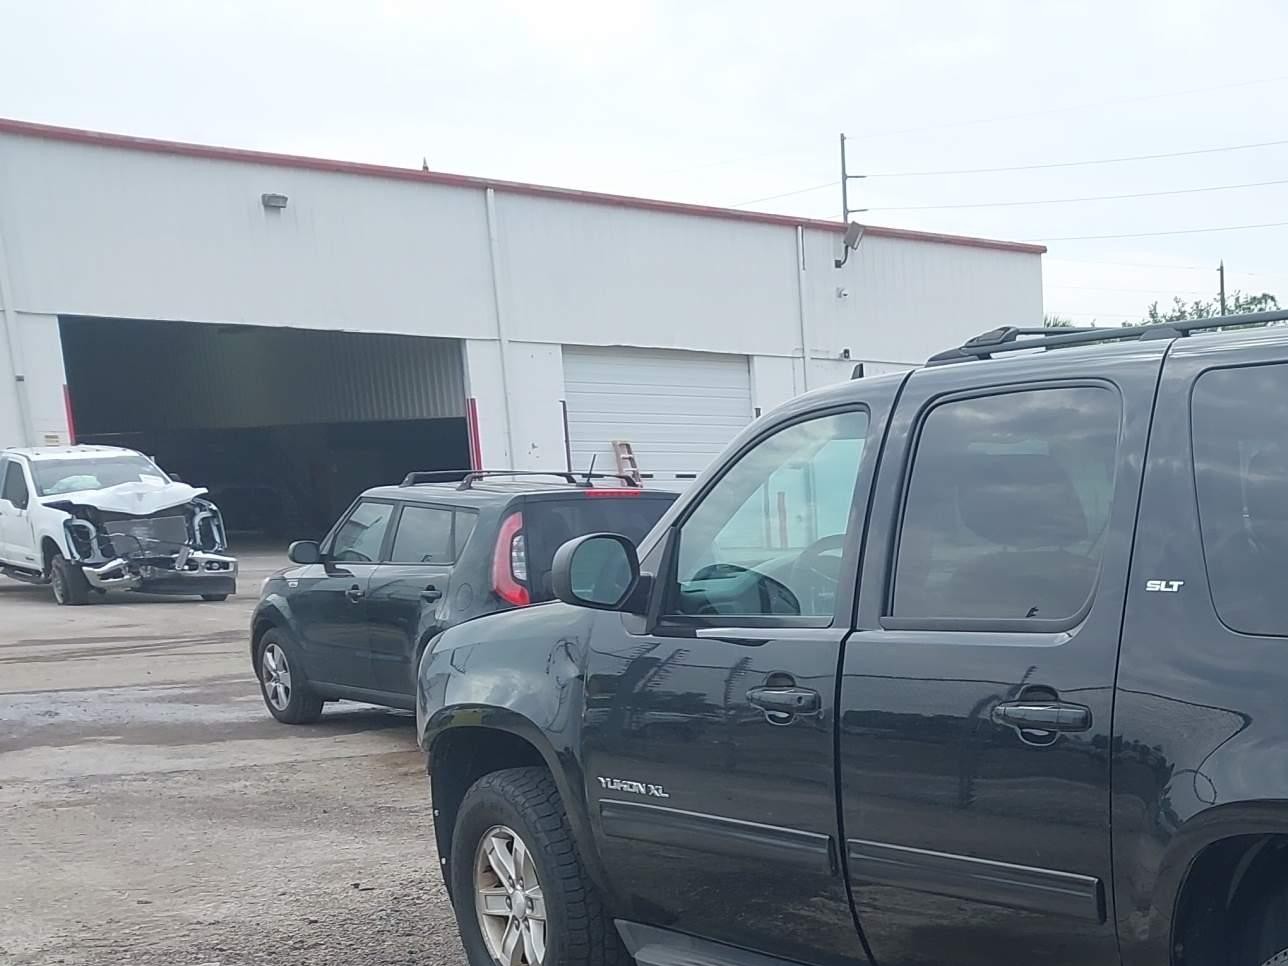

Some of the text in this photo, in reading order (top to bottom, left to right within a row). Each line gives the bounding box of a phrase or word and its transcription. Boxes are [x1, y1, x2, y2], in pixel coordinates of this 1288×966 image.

[1145, 580, 1184, 592] SLT
[597, 776, 669, 797] YUKON XL
